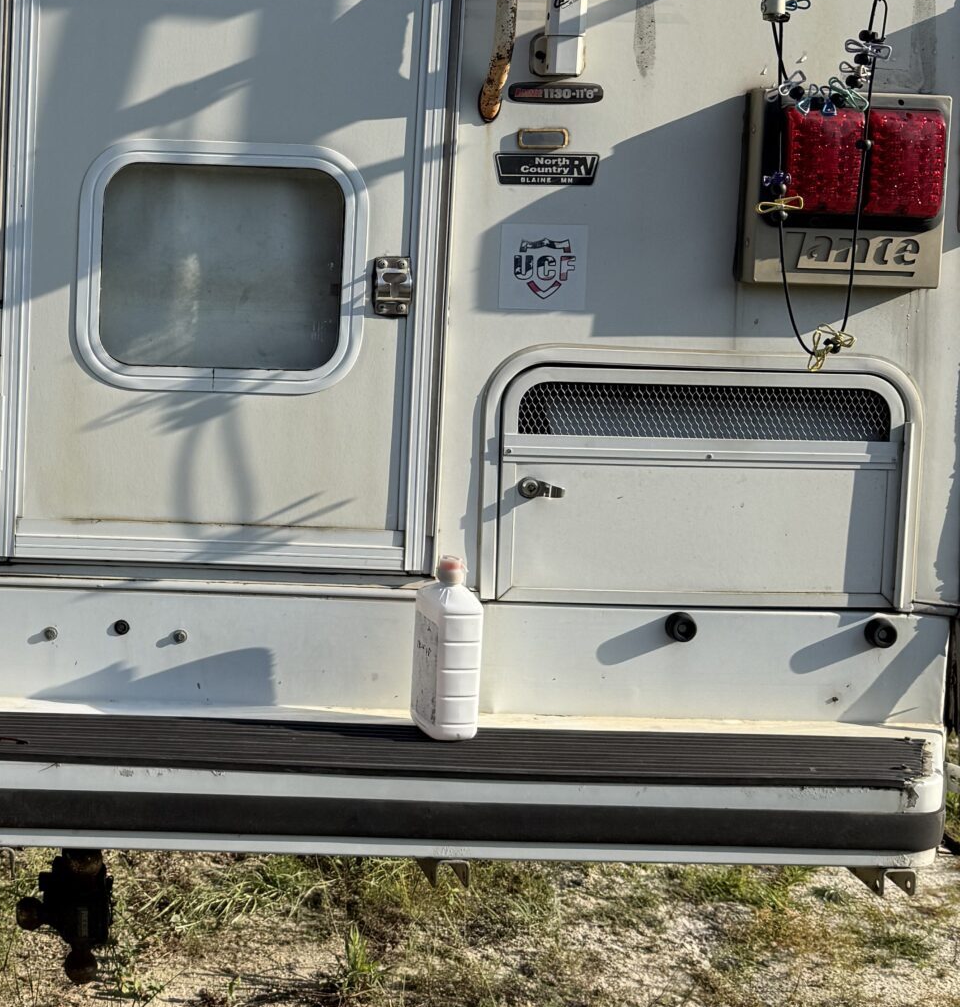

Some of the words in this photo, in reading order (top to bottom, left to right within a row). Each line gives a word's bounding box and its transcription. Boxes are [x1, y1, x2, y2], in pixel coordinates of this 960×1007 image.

[535, 157, 570, 166] North
[520, 165, 570, 175] Country
[513, 255, 576, 281] UCF
